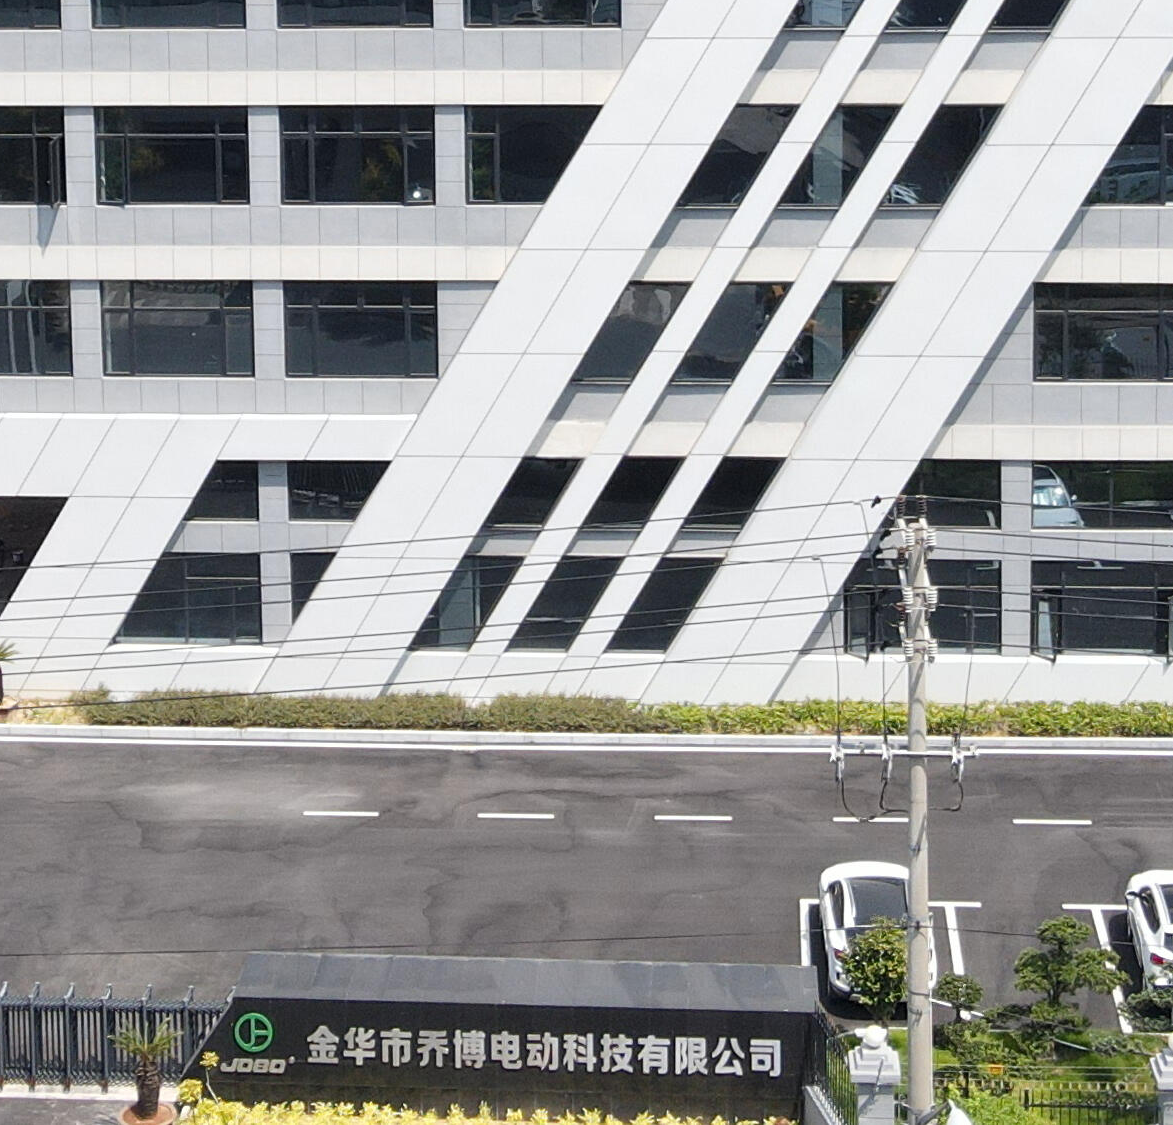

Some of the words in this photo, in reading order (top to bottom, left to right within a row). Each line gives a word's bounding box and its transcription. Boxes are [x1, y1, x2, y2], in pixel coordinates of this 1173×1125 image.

[220, 1058, 286, 1074] JOBO
[306, 1025, 781, 1077] 金华市乔博电动科技有限公司
